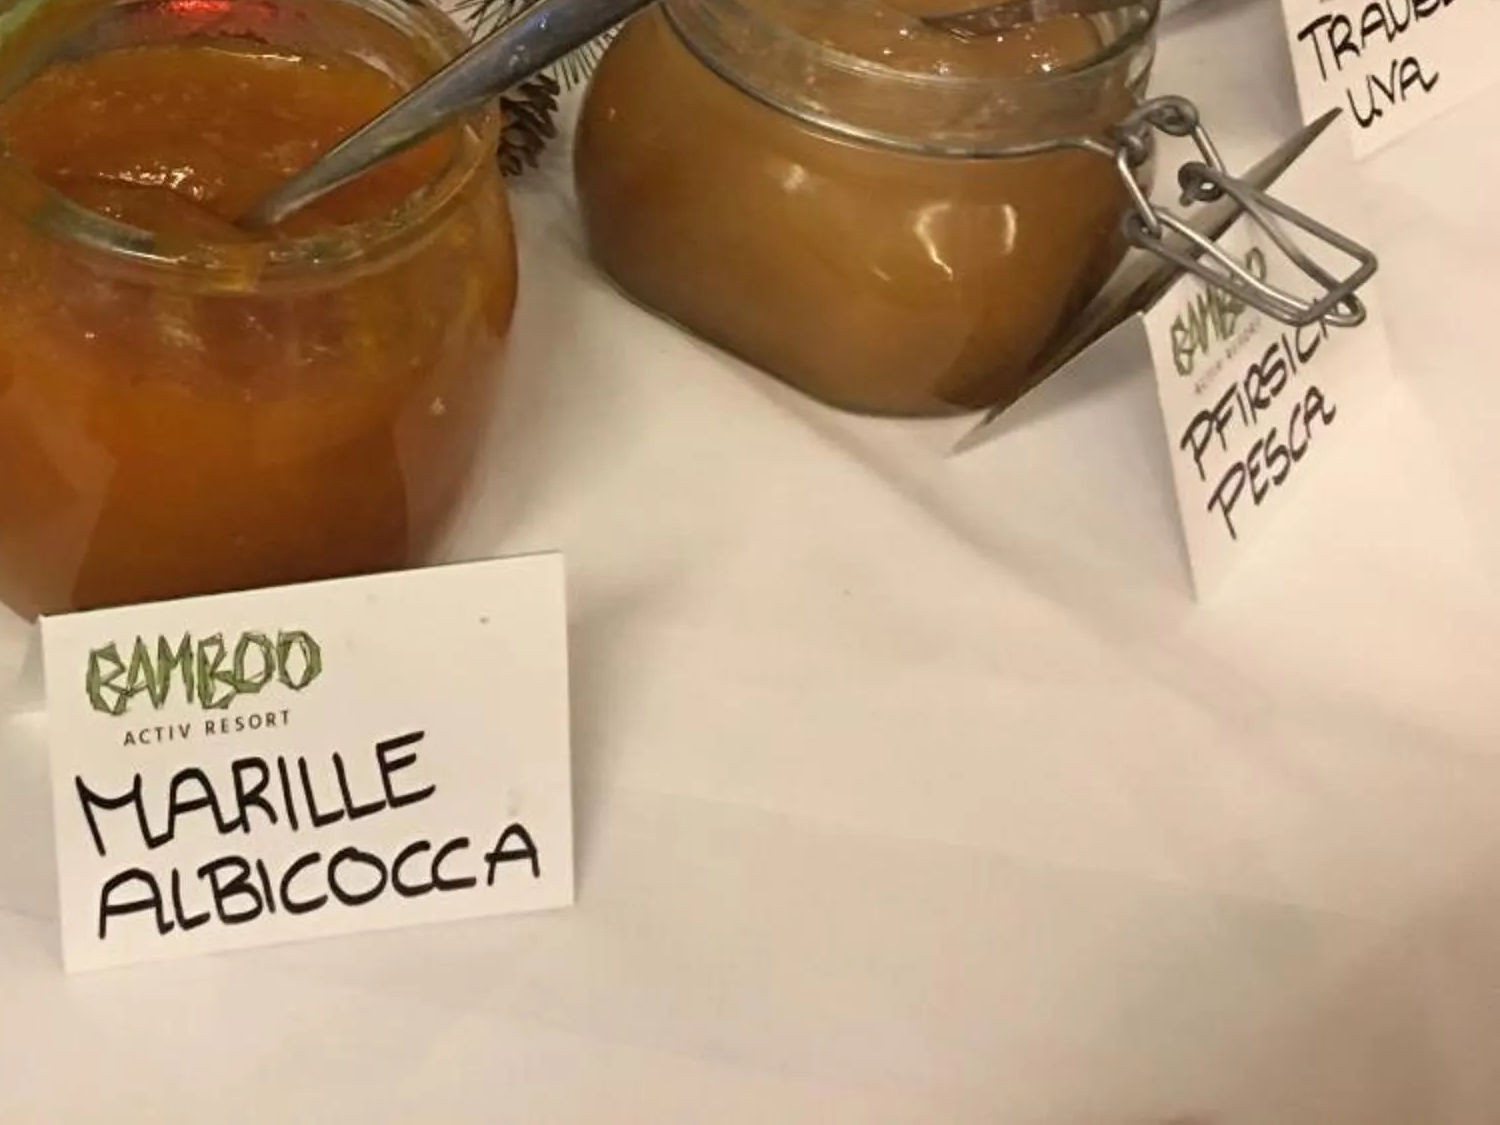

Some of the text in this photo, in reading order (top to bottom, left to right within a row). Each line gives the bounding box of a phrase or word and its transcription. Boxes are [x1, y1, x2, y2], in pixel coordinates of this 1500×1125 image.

[1347, 56, 1439, 129] UVA
[1207, 385, 1336, 540] PESCA
[86, 628, 322, 716] BAMBOO
[123, 710, 291, 747] ACTIV RESORT
[75, 730, 436, 856] MARILLE
[99, 823, 540, 939] ALBICOCCA
